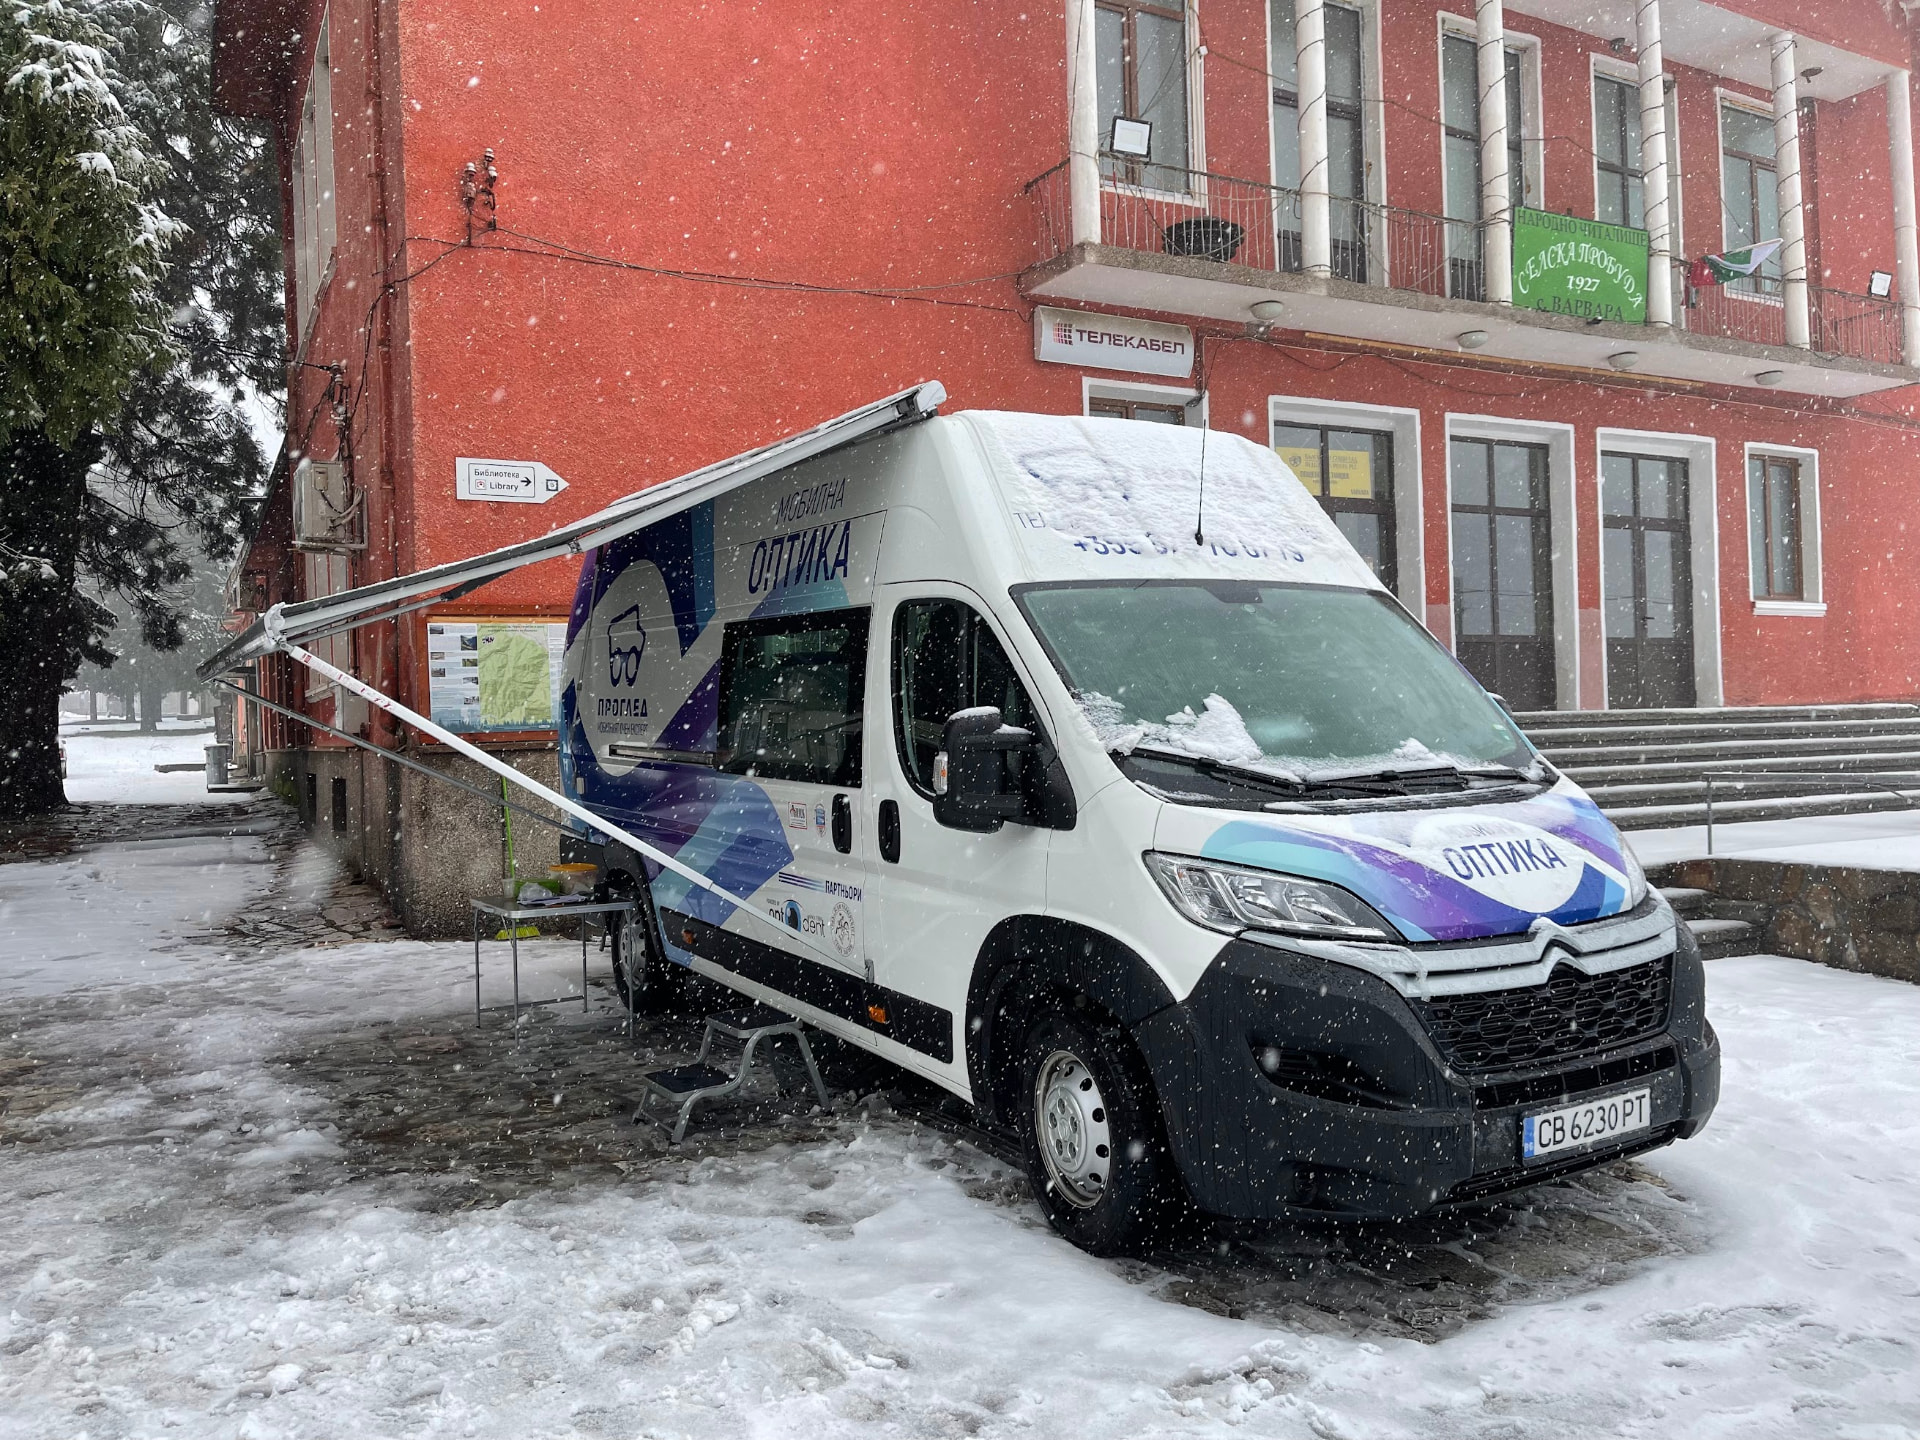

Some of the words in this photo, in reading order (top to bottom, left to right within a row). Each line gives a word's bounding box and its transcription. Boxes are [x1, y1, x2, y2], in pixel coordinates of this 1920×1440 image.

[1517, 209, 1578, 234] НАРОДНО
[1517, 241, 1576, 294] СЕЛСКА
[1578, 242, 1643, 308] ПРОБУДА
[1566, 275, 1601, 292] 1927
[1552, 295, 1625, 321] ВАРВАРА
[1075, 328, 1185, 355] ТЕЛЕКАБЕЛ
[474, 468, 520, 479] Библиотека
[489, 481, 519, 492] Library
[775, 477, 846, 525] МОБИЛНА
[748, 520, 851, 594] ОПТИКА
[597, 698, 649, 718] ПРОГЛЕД
[1442, 837, 1568, 881] ОПТИКА
[825, 879, 863, 903] ПАРТНЬОРИ
[1538, 1115, 1566, 1148] CB
[1570, 1102, 1619, 1141] 6230
[1622, 1093, 1647, 1127] PT
